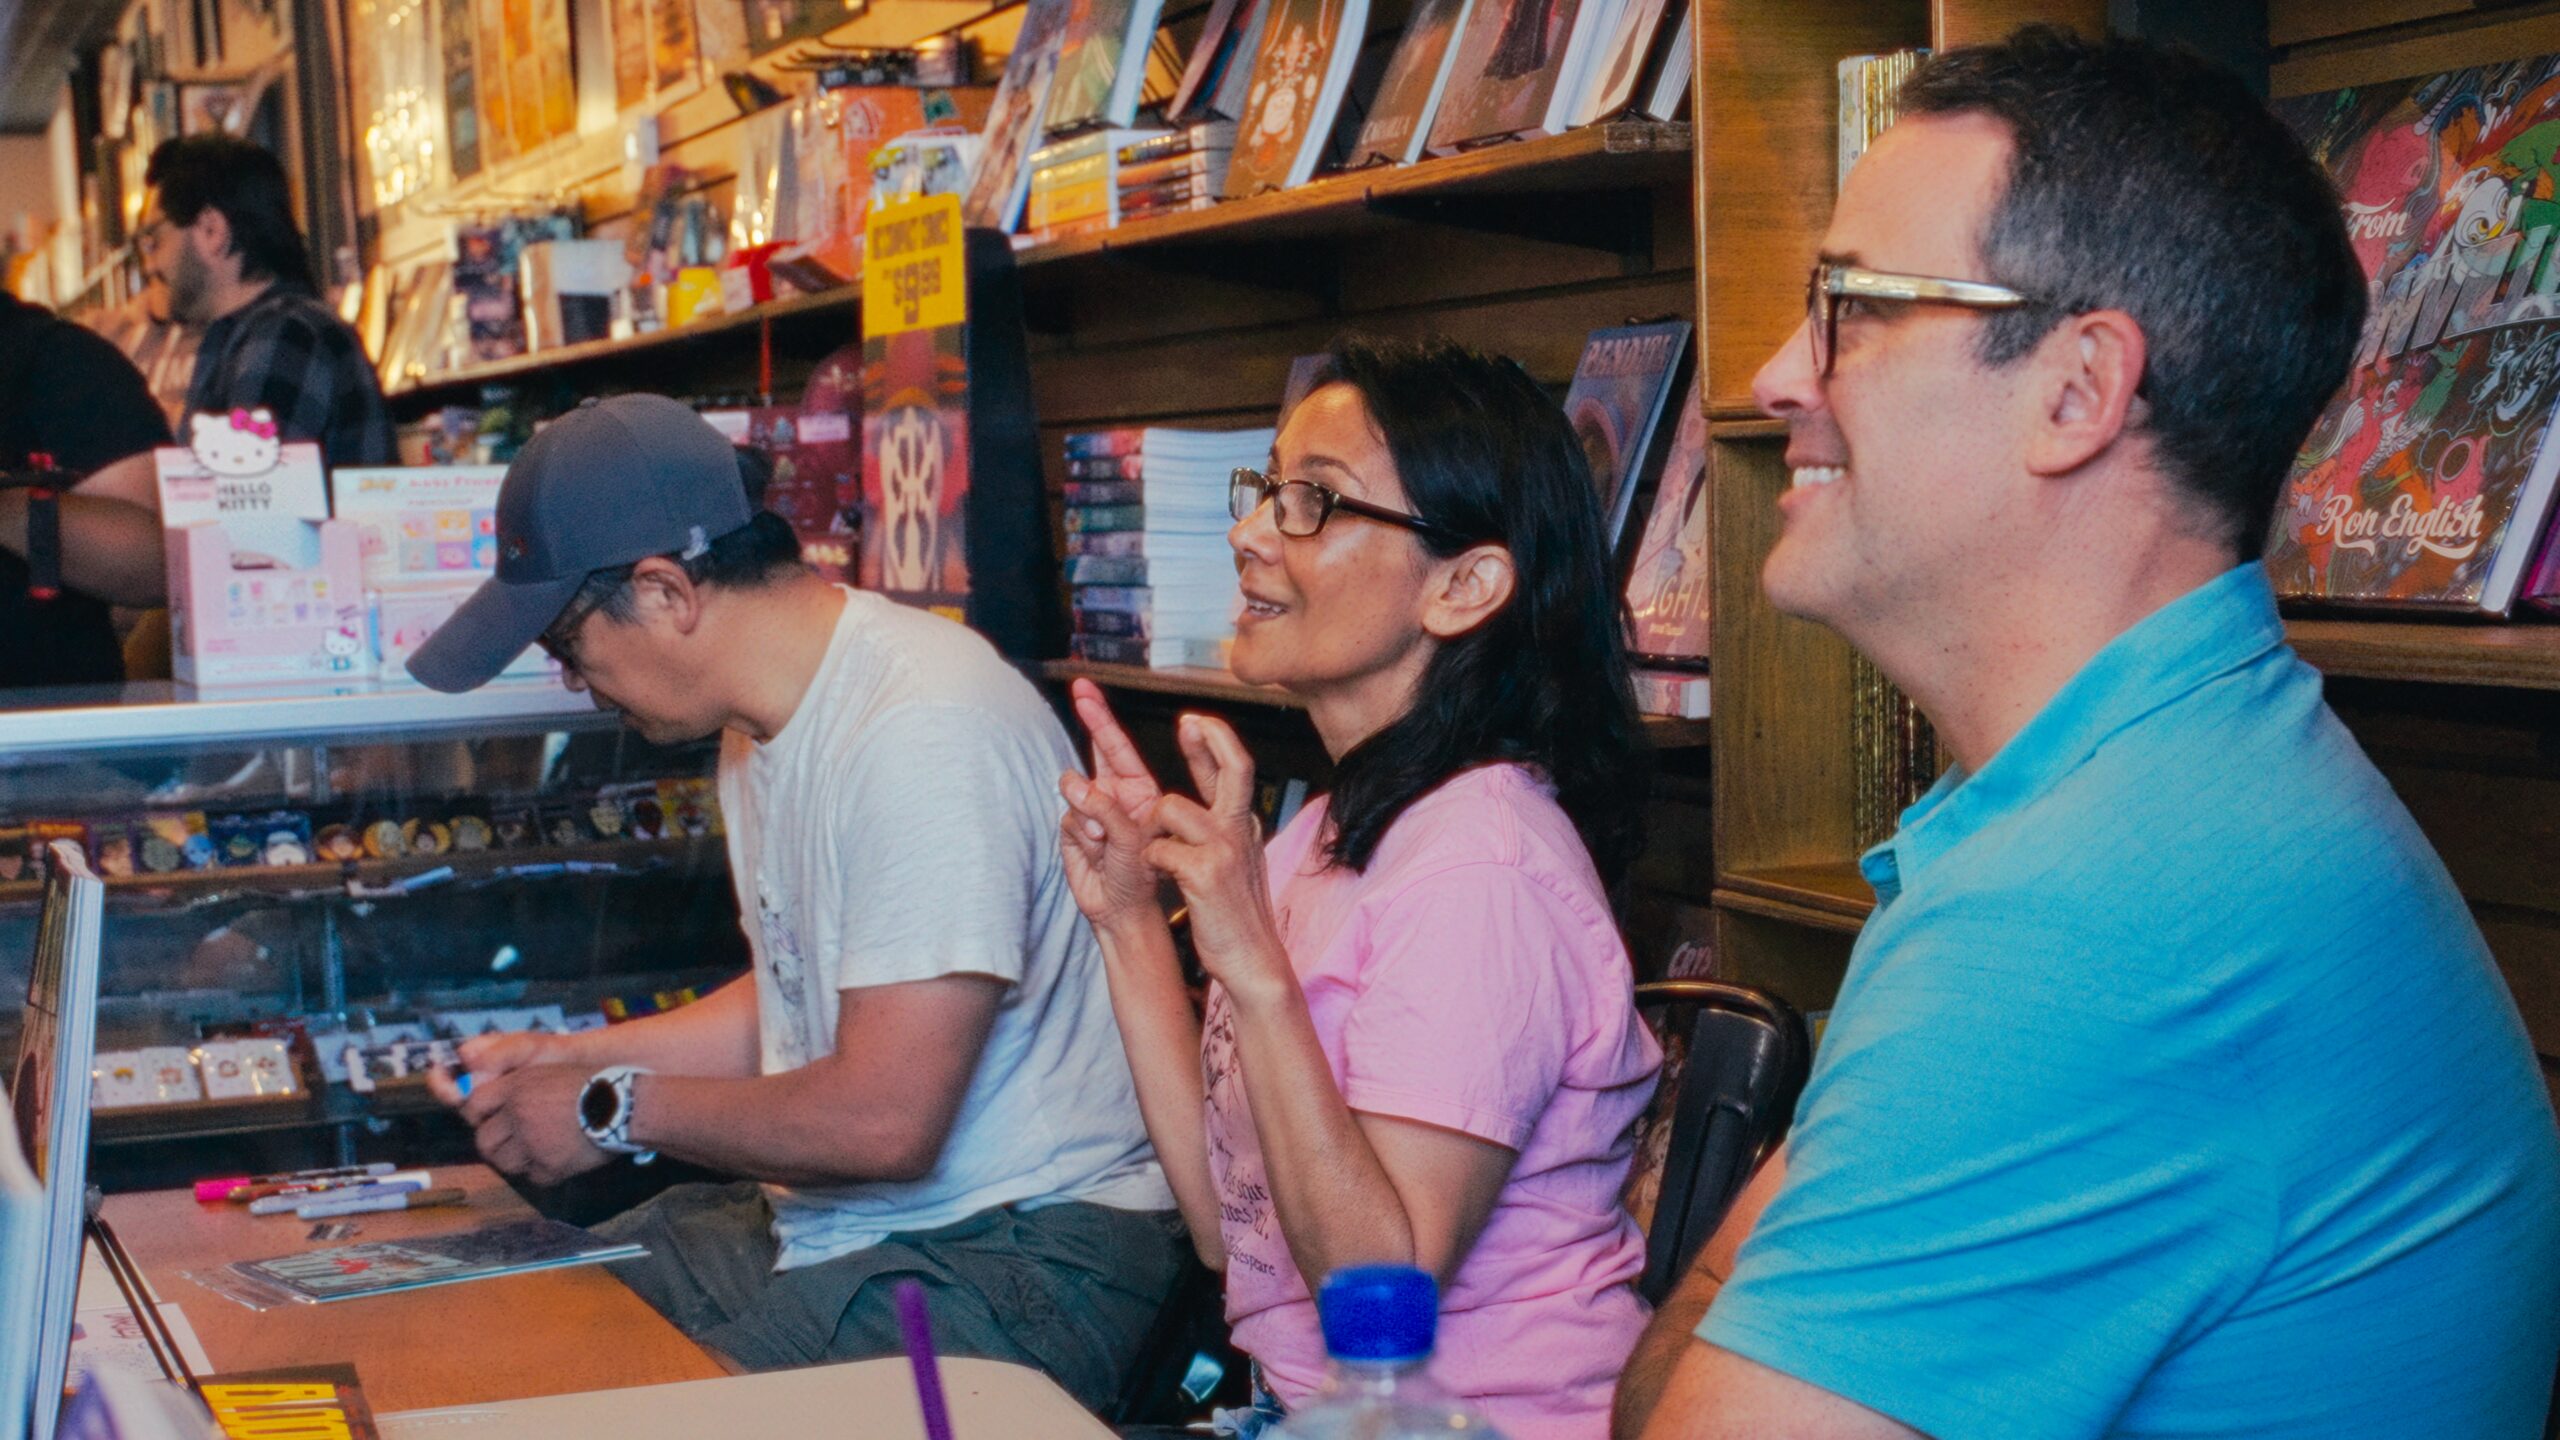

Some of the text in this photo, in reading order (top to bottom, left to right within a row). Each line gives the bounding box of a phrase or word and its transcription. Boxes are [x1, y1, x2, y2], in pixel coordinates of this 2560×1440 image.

[217, 482, 272, 496] HELLO
[218, 498, 272, 511] KITTY
[2316, 494, 2485, 560] Ron English
[200, 1383, 350, 1440] BLOO
